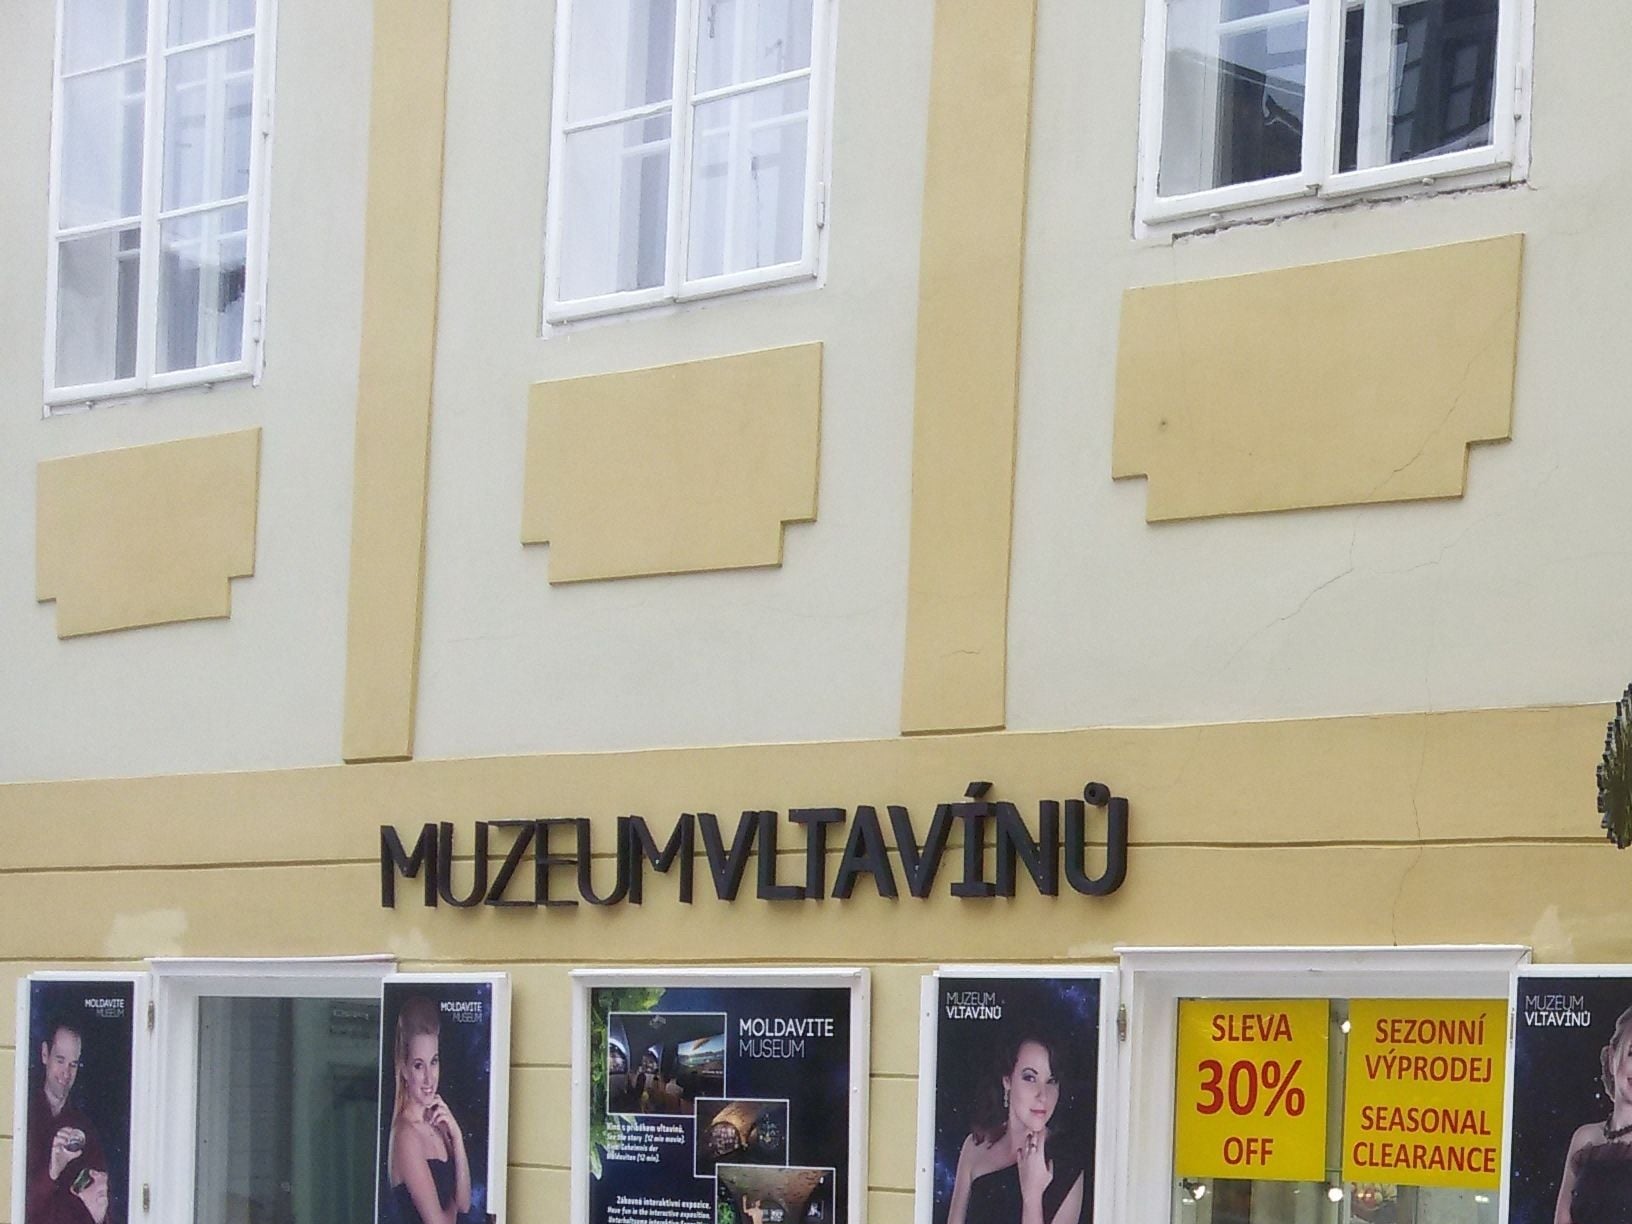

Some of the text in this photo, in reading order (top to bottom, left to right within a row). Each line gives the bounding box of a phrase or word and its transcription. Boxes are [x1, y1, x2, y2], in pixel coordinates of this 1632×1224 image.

[84, 998, 125, 1008] MOLDAVITE
[440, 1001, 482, 1012] MOLDAVITE
[946, 991, 996, 1006] MUZEUM
[1525, 995, 1584, 1010] MUZEUM
[945, 1005, 1002, 1019] VLTAVÍNŮ
[1524, 1009, 1591, 1026] VLTAVÍNŮ
[739, 1018, 834, 1037] MOLDAVITE
[1211, 1014, 1293, 1042] SLEVA
[1375, 1013, 1487, 1045] SEZONNÍ
[739, 1039, 805, 1058] MUSEUM
[1365, 1048, 1492, 1083] VÝPRODEJ
[1196, 1059, 1305, 1117] 30%
[1361, 1105, 1491, 1136] SEASONAL
[1223, 1137, 1274, 1166] OFF
[1353, 1141, 1496, 1173] CLEARANCE
